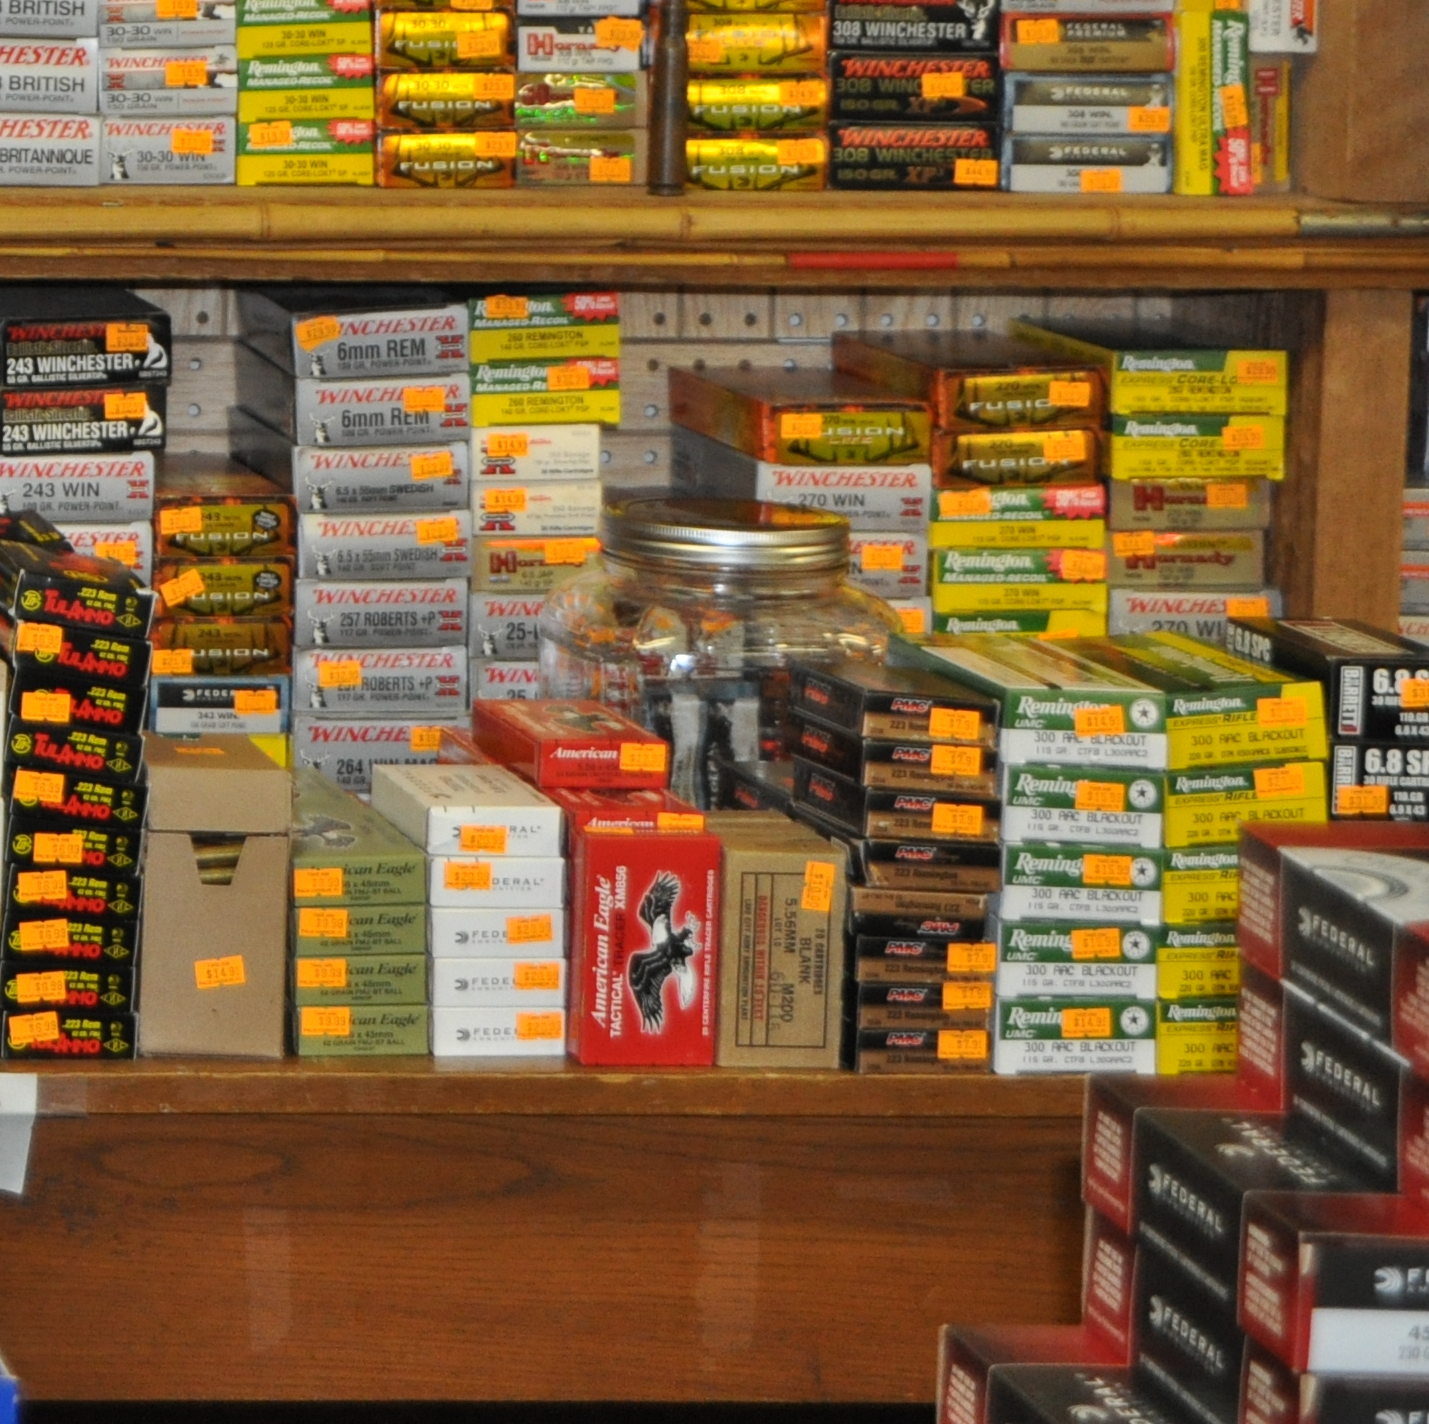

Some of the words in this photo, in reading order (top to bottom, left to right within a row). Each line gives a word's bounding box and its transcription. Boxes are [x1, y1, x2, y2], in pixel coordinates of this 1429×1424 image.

[8, 0, 85, 17] BRITISH
[833, 21, 863, 37] 308
[866, 21, 966, 40] WINCHESTER
[398, 159, 492, 172] FUSION
[336, 339, 383, 360] 6mm
[386, 338, 427, 360] REM
[6, 355, 36, 374] 243
[37, 353, 135, 374] WINCHESTER
[22, 483, 60, 498] 243
[63, 483, 101, 499] WIN
[76, 587, 98, 600] .223
[340, 612, 361, 627] 257
[364, 611, 416, 627] ROBERTS
[420, 609, 437, 625] +P
[890, 697, 932, 713] PMC
[1173, 696, 1243, 714] Remington
[1345, 669, 1360, 734] BARRETT
[1034, 732, 1059, 745] 300
[1090, 732, 1148, 745] BLACKOUT
[1364, 747, 1402, 775] 6.8
[613, 864, 628, 911] XM856
[592, 874, 614, 932] Eagle
[783, 897, 798, 954] 5.56MM
[1312, 914, 1376, 967] FEDERAL
[797, 937, 812, 985] BLANK
[590, 933, 610, 1029] American
[608, 972, 624, 1038] TACTICAL
[780, 982, 795, 1023] M200
[1315, 1048, 1382, 1106] FEDERAL
